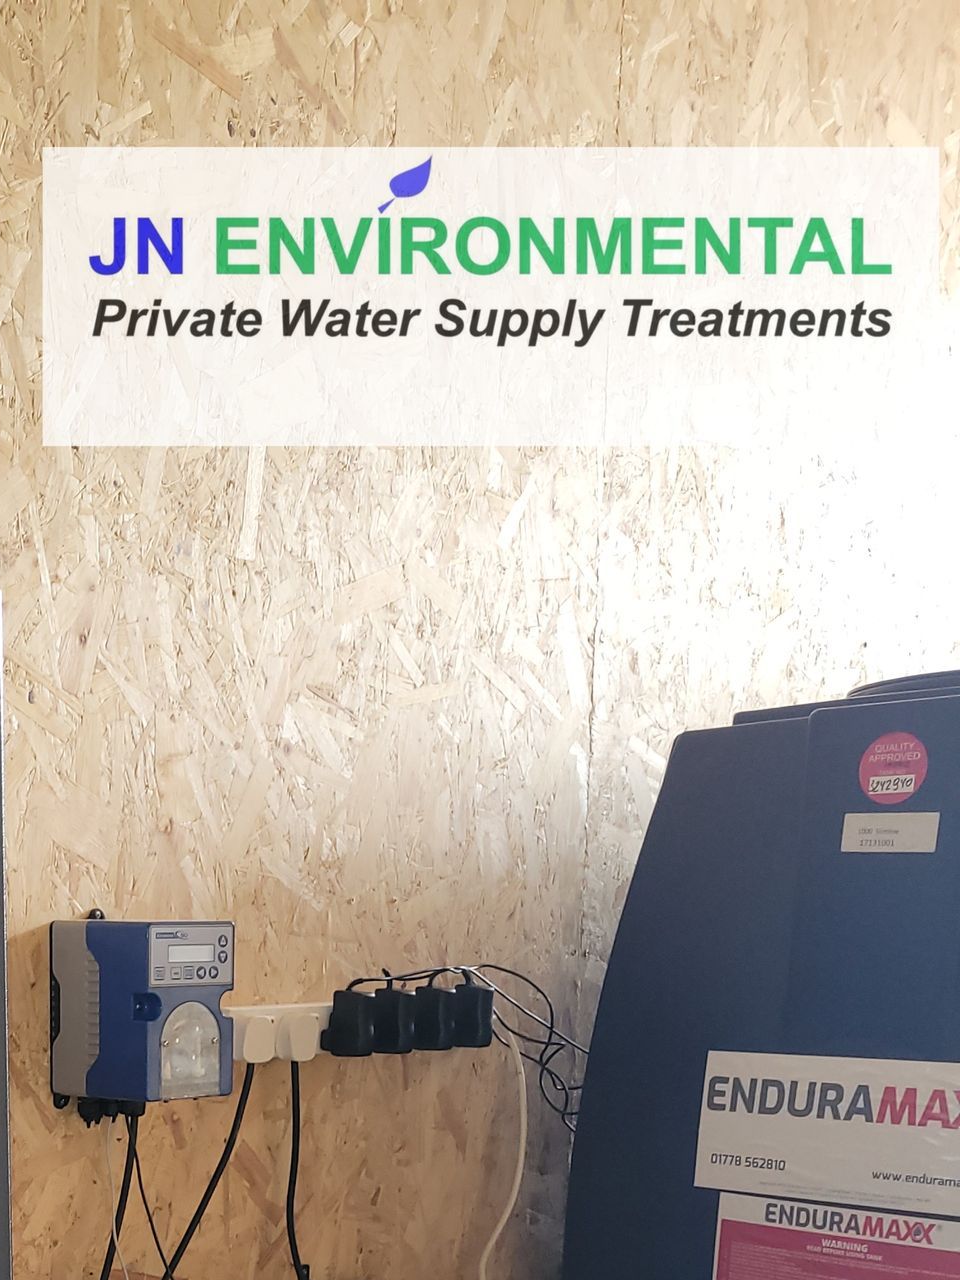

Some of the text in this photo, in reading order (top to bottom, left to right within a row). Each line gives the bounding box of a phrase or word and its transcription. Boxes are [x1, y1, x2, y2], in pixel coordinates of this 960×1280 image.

[875, 742, 915, 753] QUALITY
[869, 751, 921, 763] APPROVED
[707, 1075, 960, 1130] ENDURAMA
[710, 1153, 786, 1171] 01778 562810
[765, 1202, 936, 1245] ENDURAMAXX
[821, 1238, 868, 1253] WARNING
